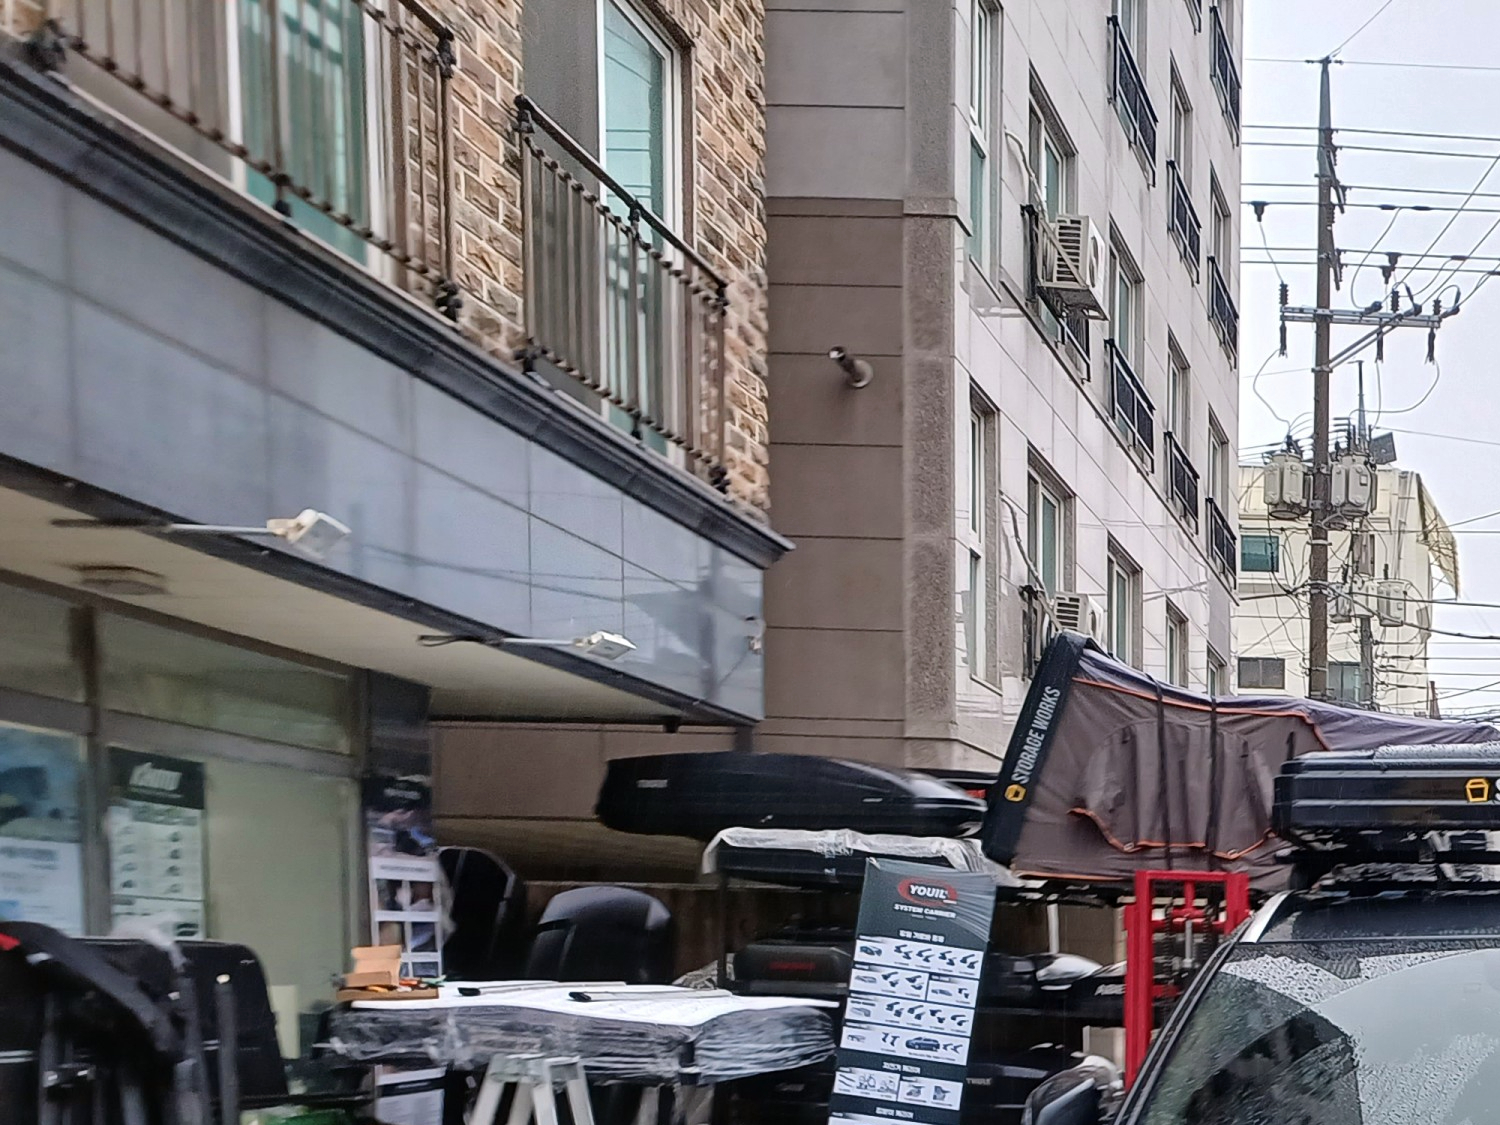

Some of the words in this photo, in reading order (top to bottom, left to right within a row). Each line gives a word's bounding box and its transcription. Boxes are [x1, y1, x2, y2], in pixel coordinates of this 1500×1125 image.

[1011, 729, 1045, 784] STORAGE
[1031, 686, 1061, 731] WORKS
[910, 884, 948, 899] YOUIL
[893, 903, 924, 914] SYSTEM
